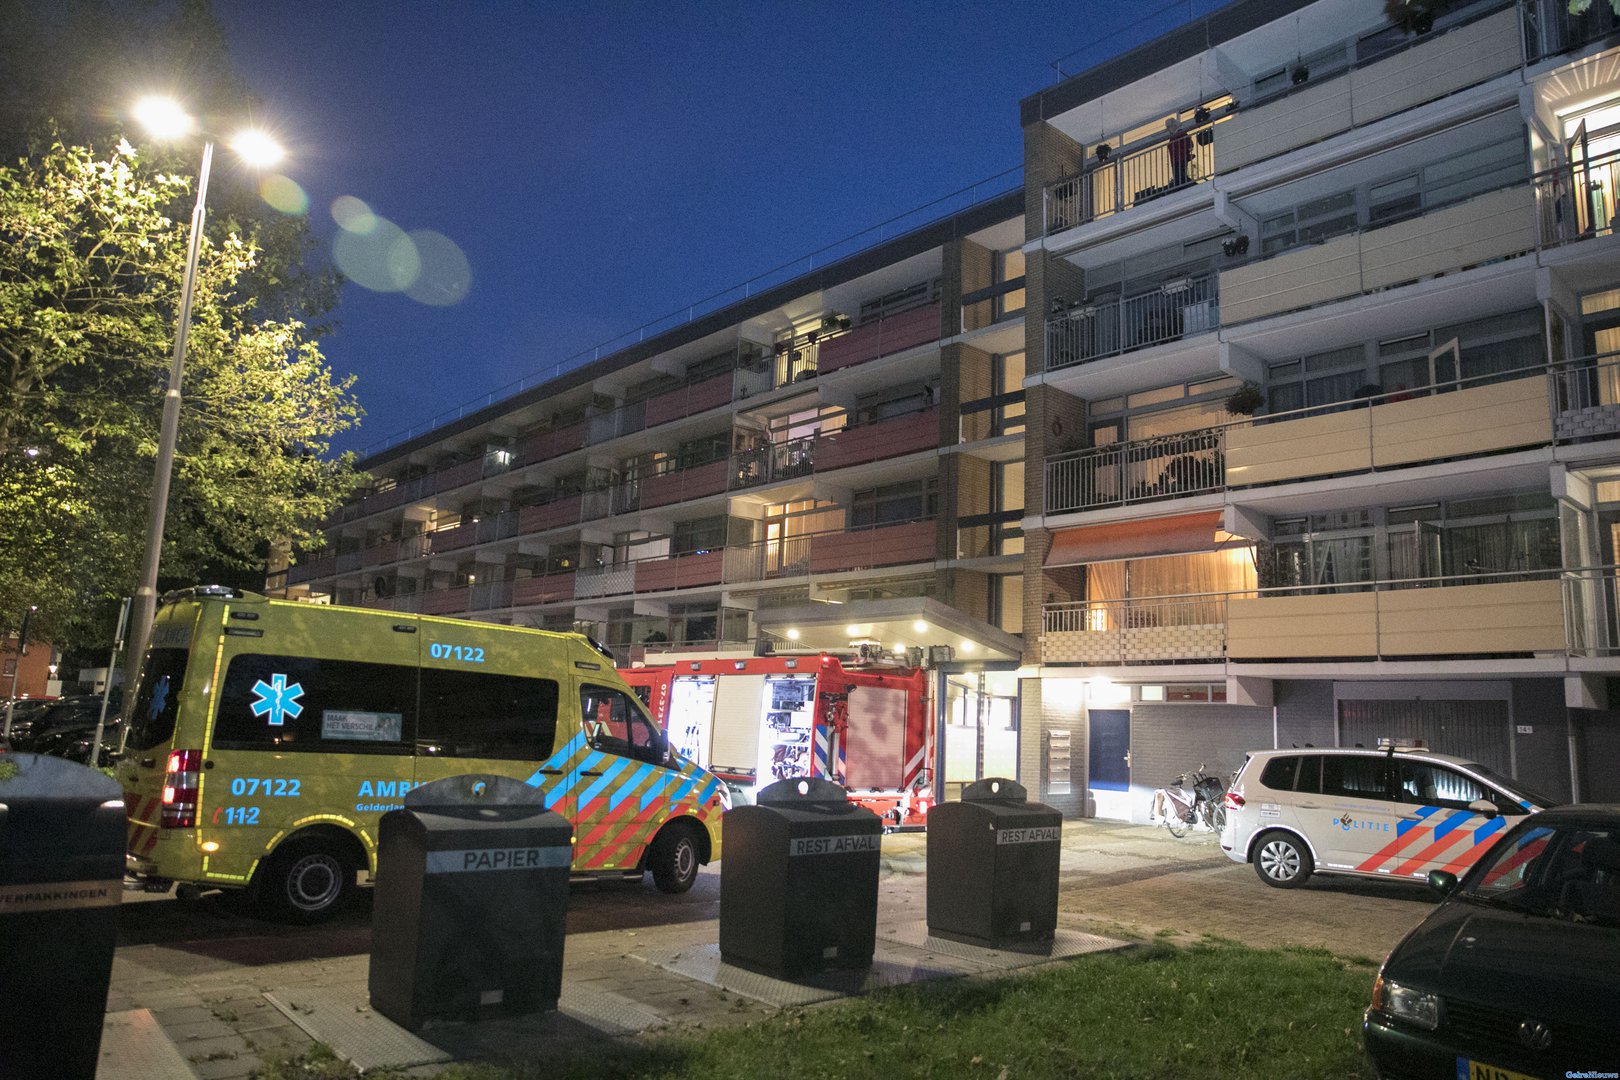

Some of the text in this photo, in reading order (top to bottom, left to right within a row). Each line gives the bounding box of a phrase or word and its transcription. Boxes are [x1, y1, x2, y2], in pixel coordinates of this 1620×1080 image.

[430, 643, 485, 662] 07122
[326, 722, 340, 730] HET
[231, 777, 301, 796] 07122
[357, 780, 427, 798] AMB
[1333, 817, 1390, 832] POLITIE
[1002, 828, 1058, 843] REST AFVAL
[797, 837, 875, 854] REST AFVAL
[464, 849, 539, 869] PAPIER
